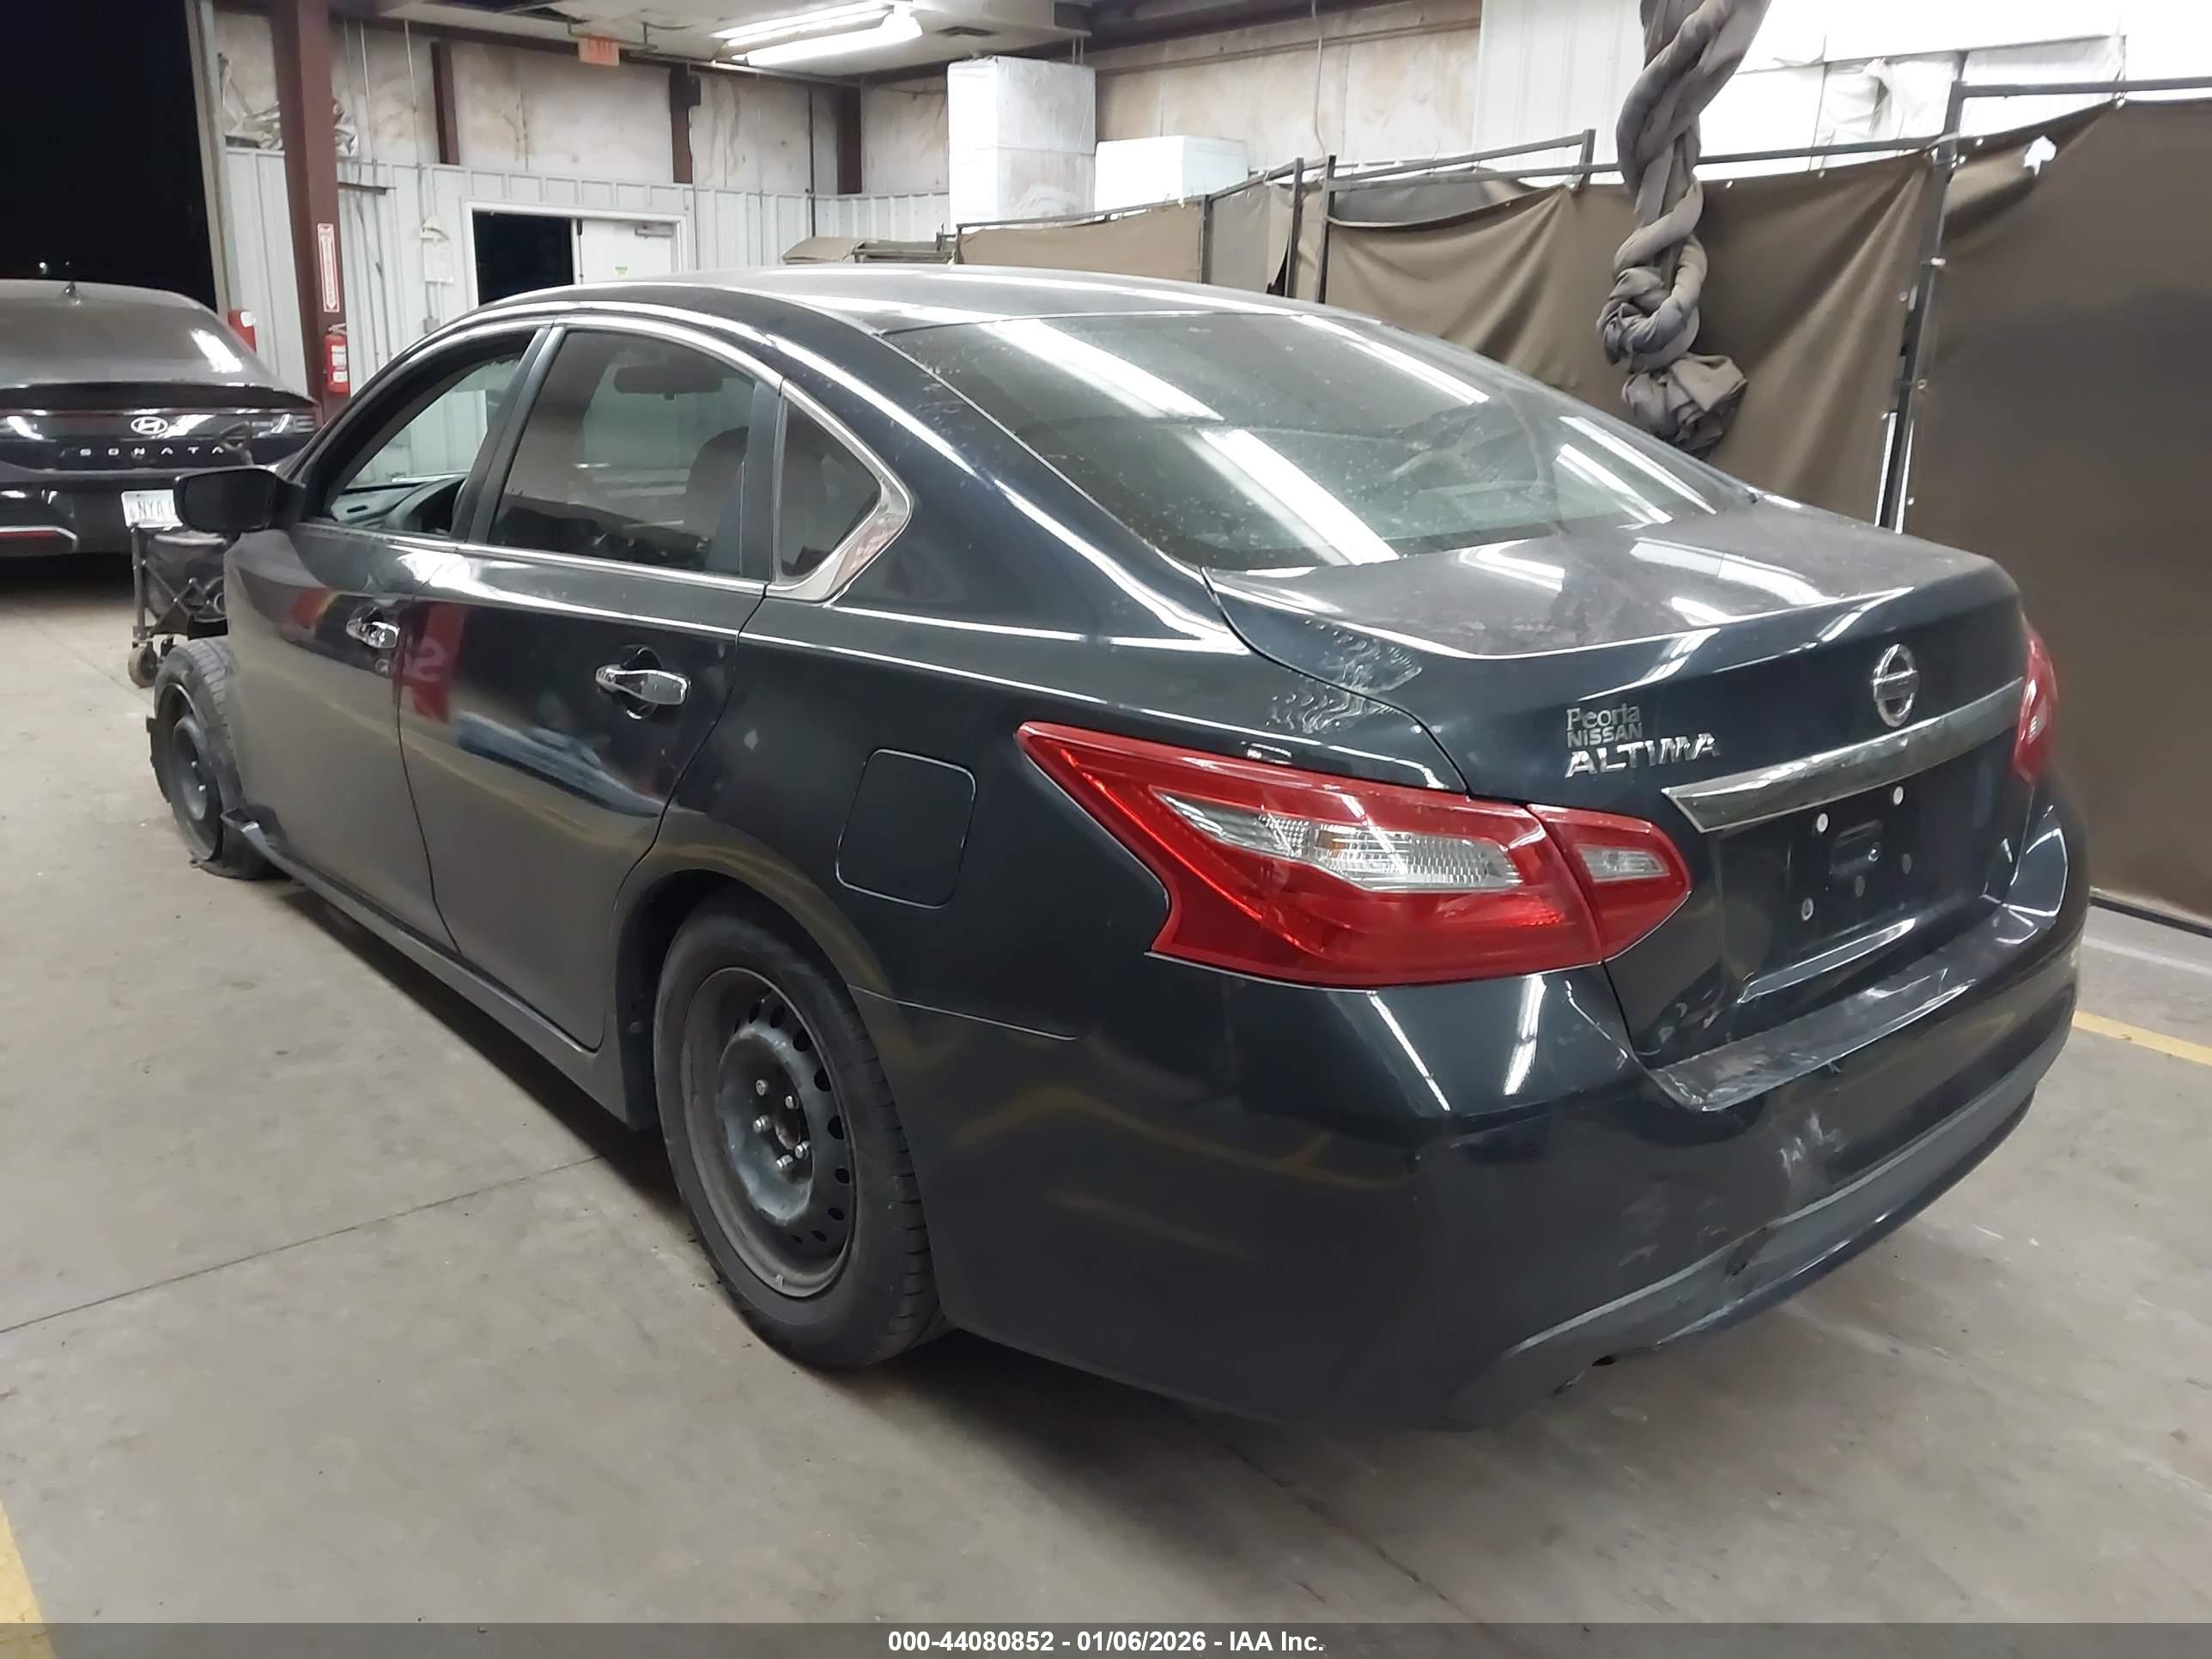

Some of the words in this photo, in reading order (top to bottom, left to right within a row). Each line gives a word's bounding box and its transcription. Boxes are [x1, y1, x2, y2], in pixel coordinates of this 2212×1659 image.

[79, 446, 225, 457] SONATA
[1566, 703, 1641, 730] Peoria
[1567, 722, 1644, 748] NISSAN
[1565, 732, 1720, 778] ALTIMA
